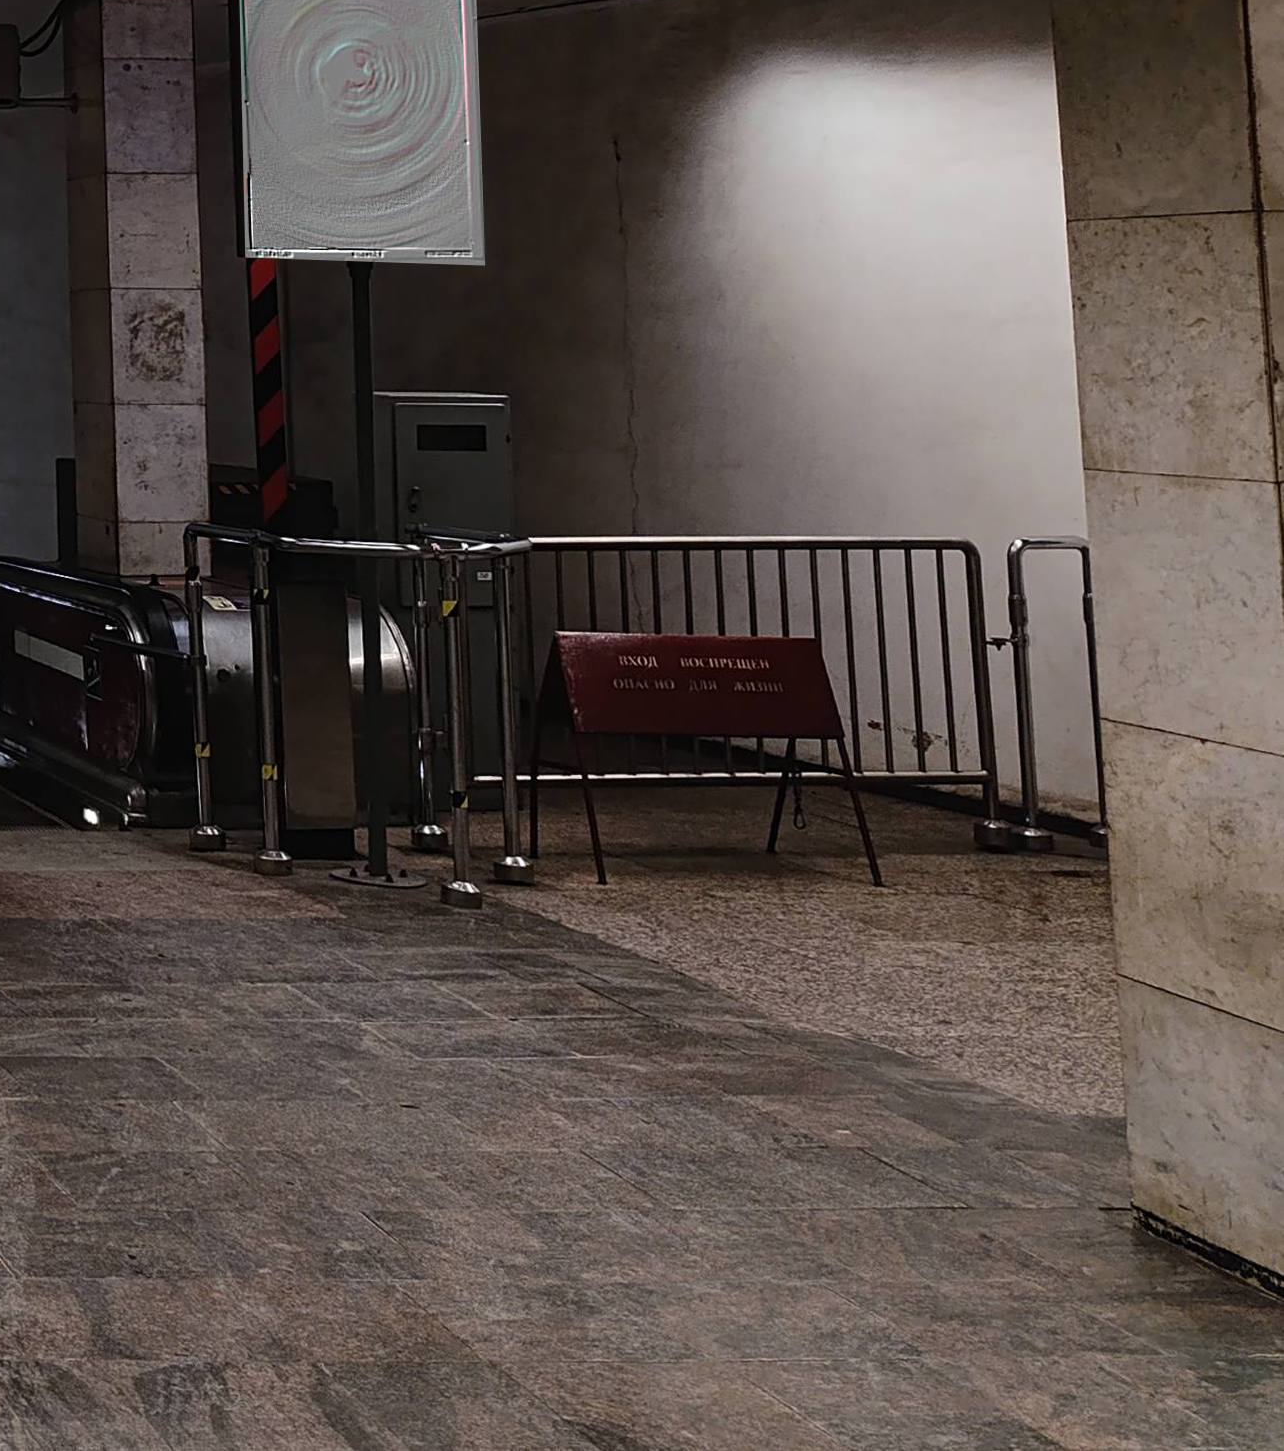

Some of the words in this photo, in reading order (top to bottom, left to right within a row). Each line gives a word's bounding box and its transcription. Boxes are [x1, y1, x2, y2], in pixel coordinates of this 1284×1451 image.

[618, 655, 658, 668] ВХОД
[680, 657, 769, 670] ВОСПРЕЩЕН
[613, 678, 675, 691] ОПАСНО
[689, 679, 718, 693] ДЛЯ
[733, 680, 783, 693] ЖИЗНИ
